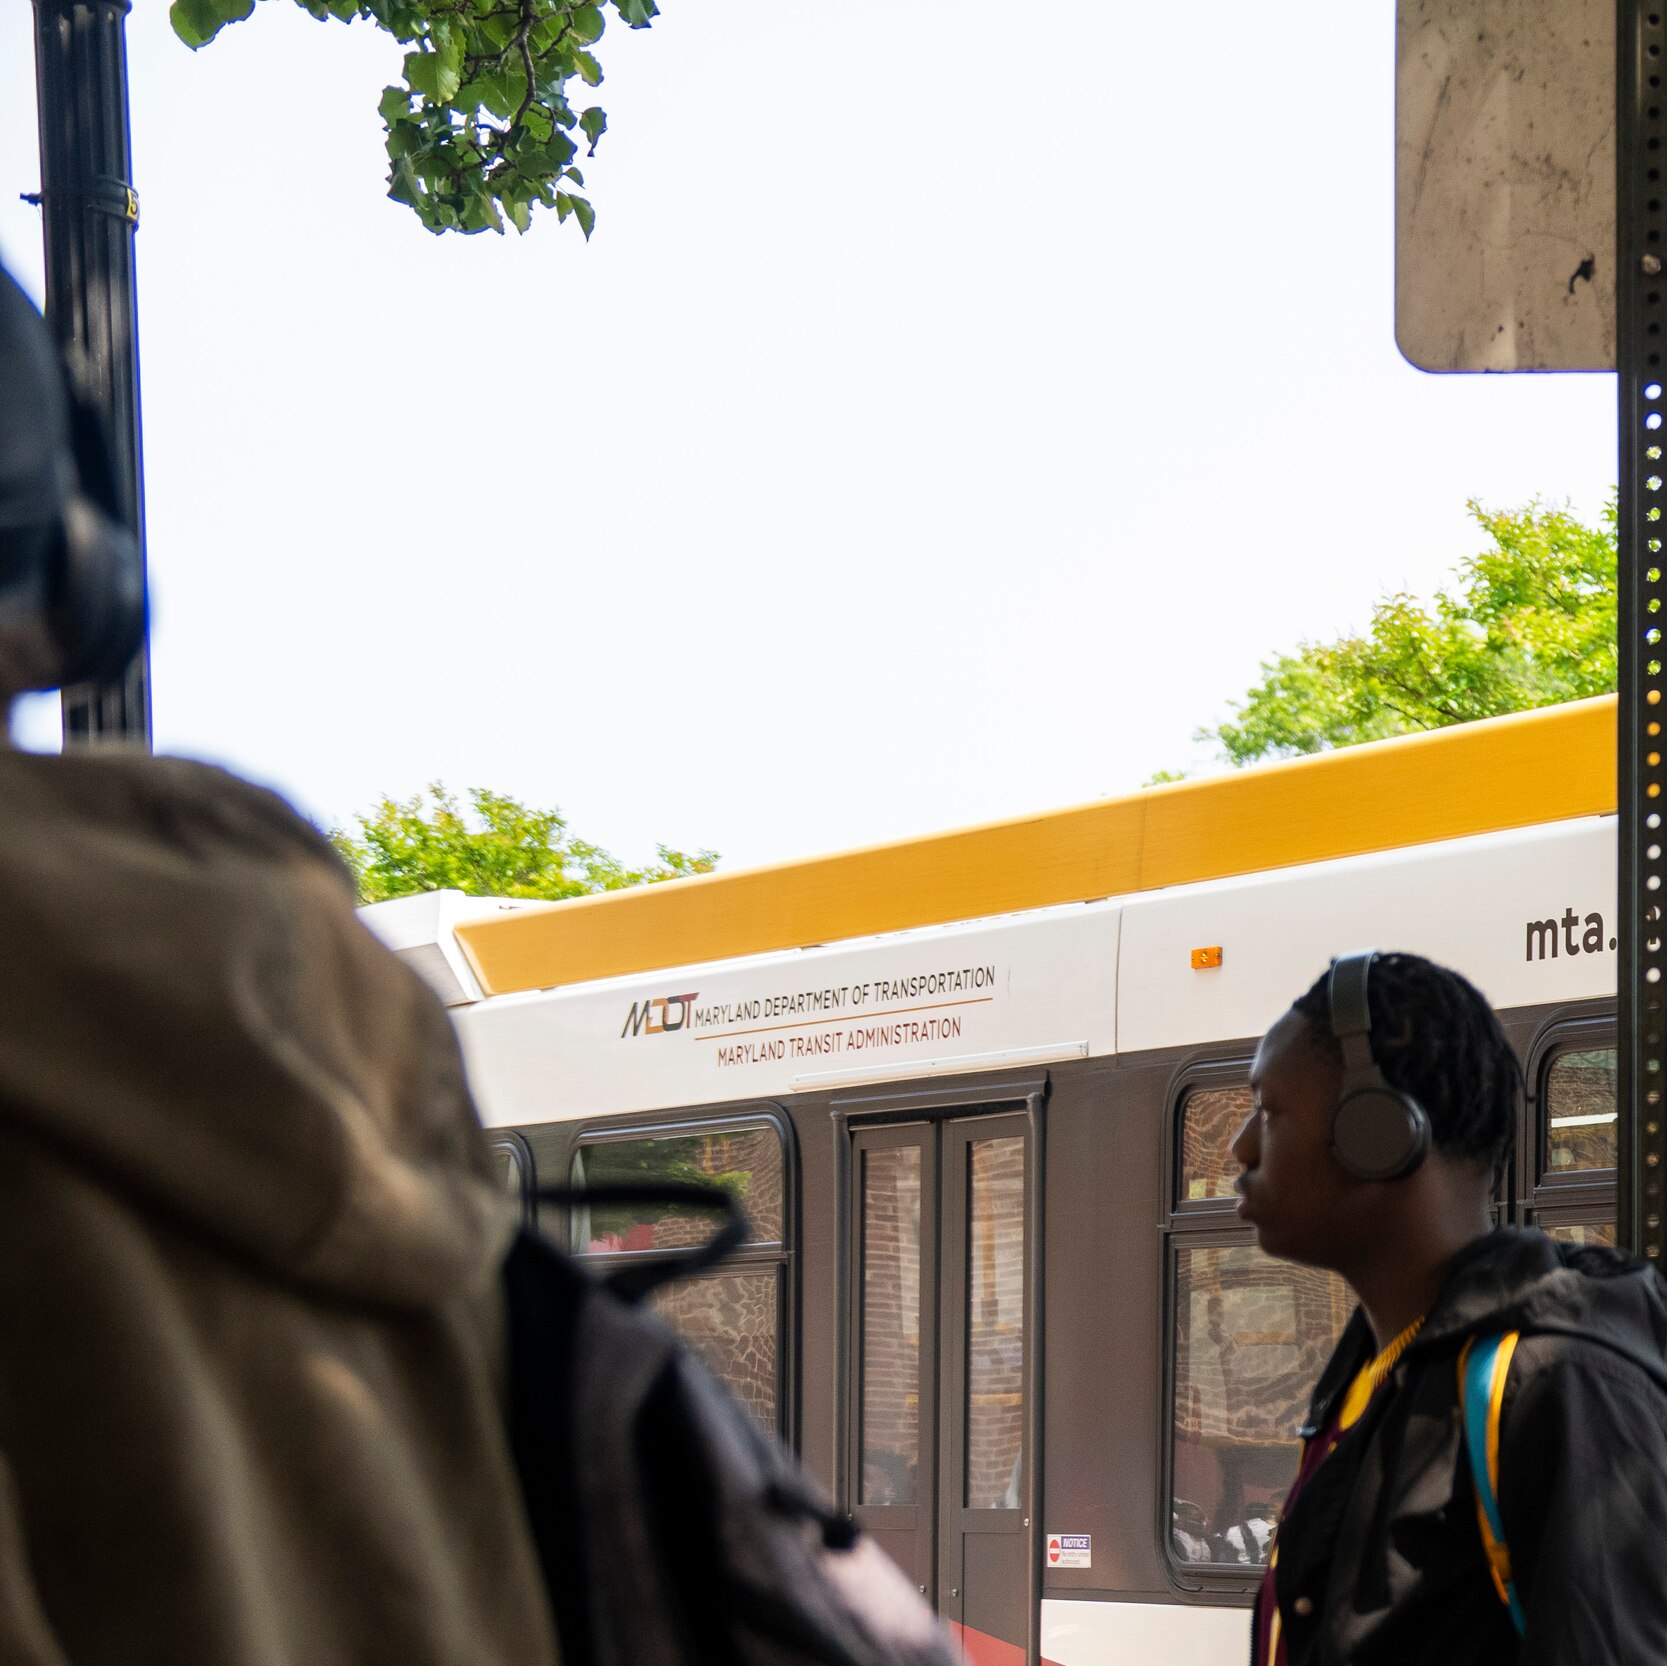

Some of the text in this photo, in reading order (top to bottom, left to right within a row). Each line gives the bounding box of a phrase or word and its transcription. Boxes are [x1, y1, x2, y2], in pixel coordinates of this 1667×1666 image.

[621, 992, 700, 1038] MDOT
[695, 965, 995, 1028] MARYLAND DEPARTMENT OF TRANSPORTATION
[717, 1017, 961, 1067] MARYLAND TRANSIT ADMINISTRATION
[1063, 1538, 1088, 1548] NOTICE
